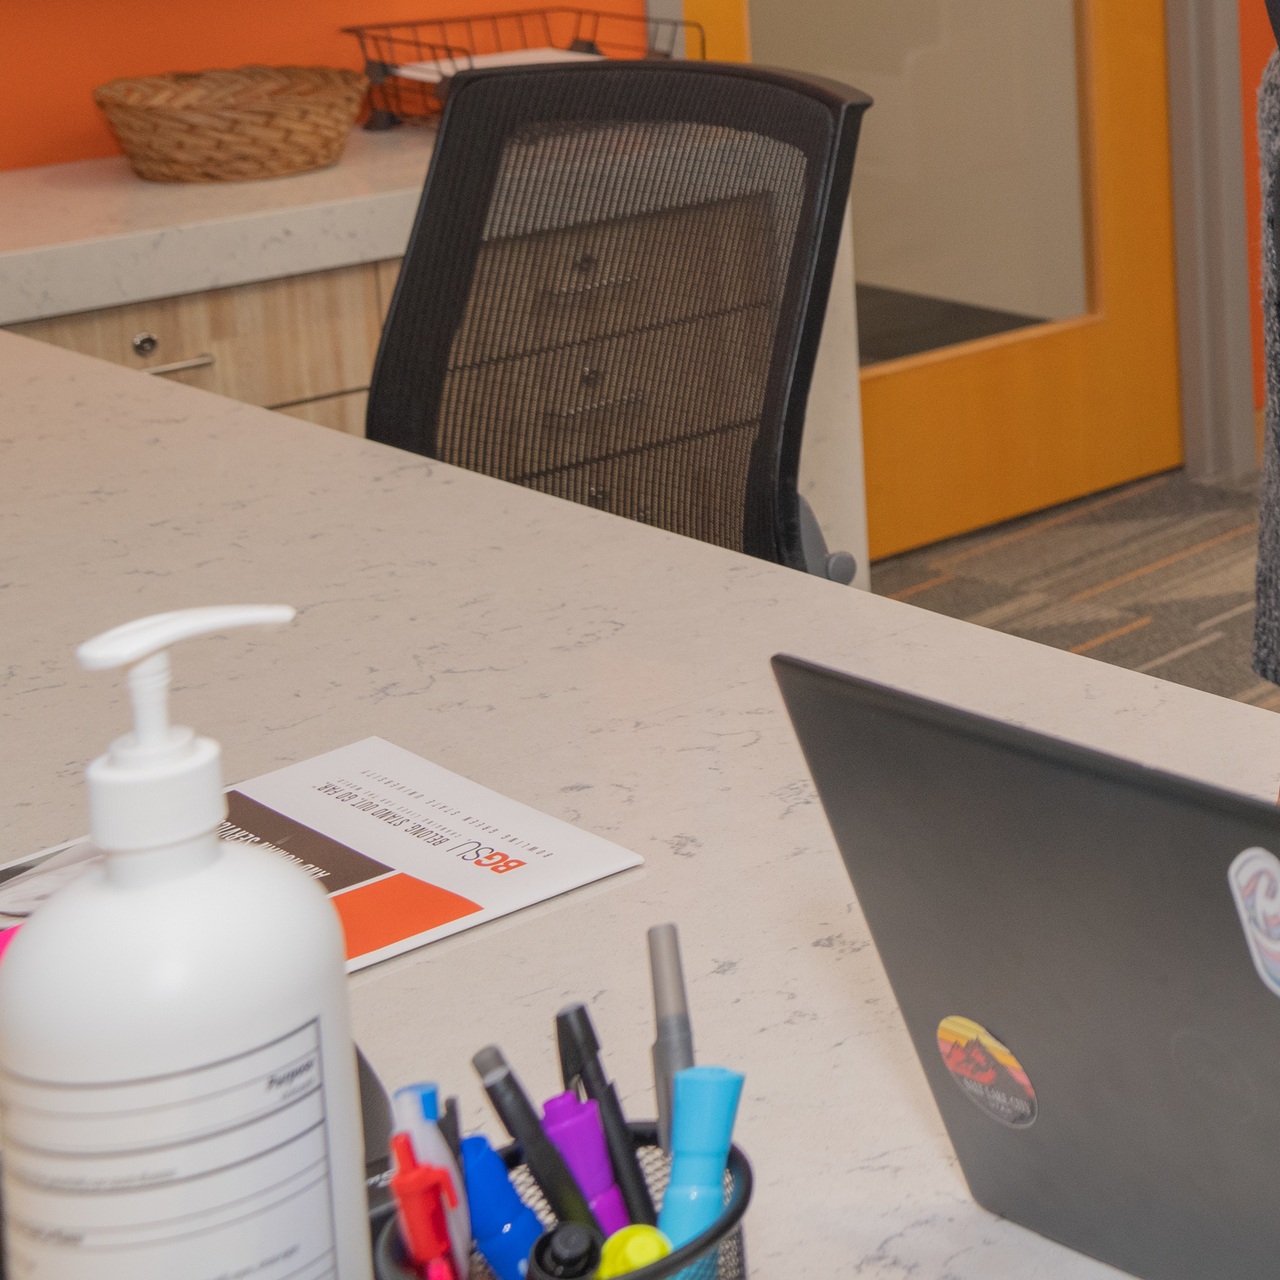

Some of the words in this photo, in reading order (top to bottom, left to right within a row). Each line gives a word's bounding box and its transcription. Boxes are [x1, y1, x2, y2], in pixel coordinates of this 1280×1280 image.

[360, 769, 425, 800] UNIVERSITY
[335, 791, 359, 803] GO
[350, 797, 380, 813] OUT.
[370, 807, 411, 827] STAND
[424, 799, 461, 816] STATE
[404, 822, 450, 847] BELONG.
[462, 816, 499, 835] GREEN
[500, 833, 554, 858] BOWLING
[445, 839, 528, 875] BGSU
